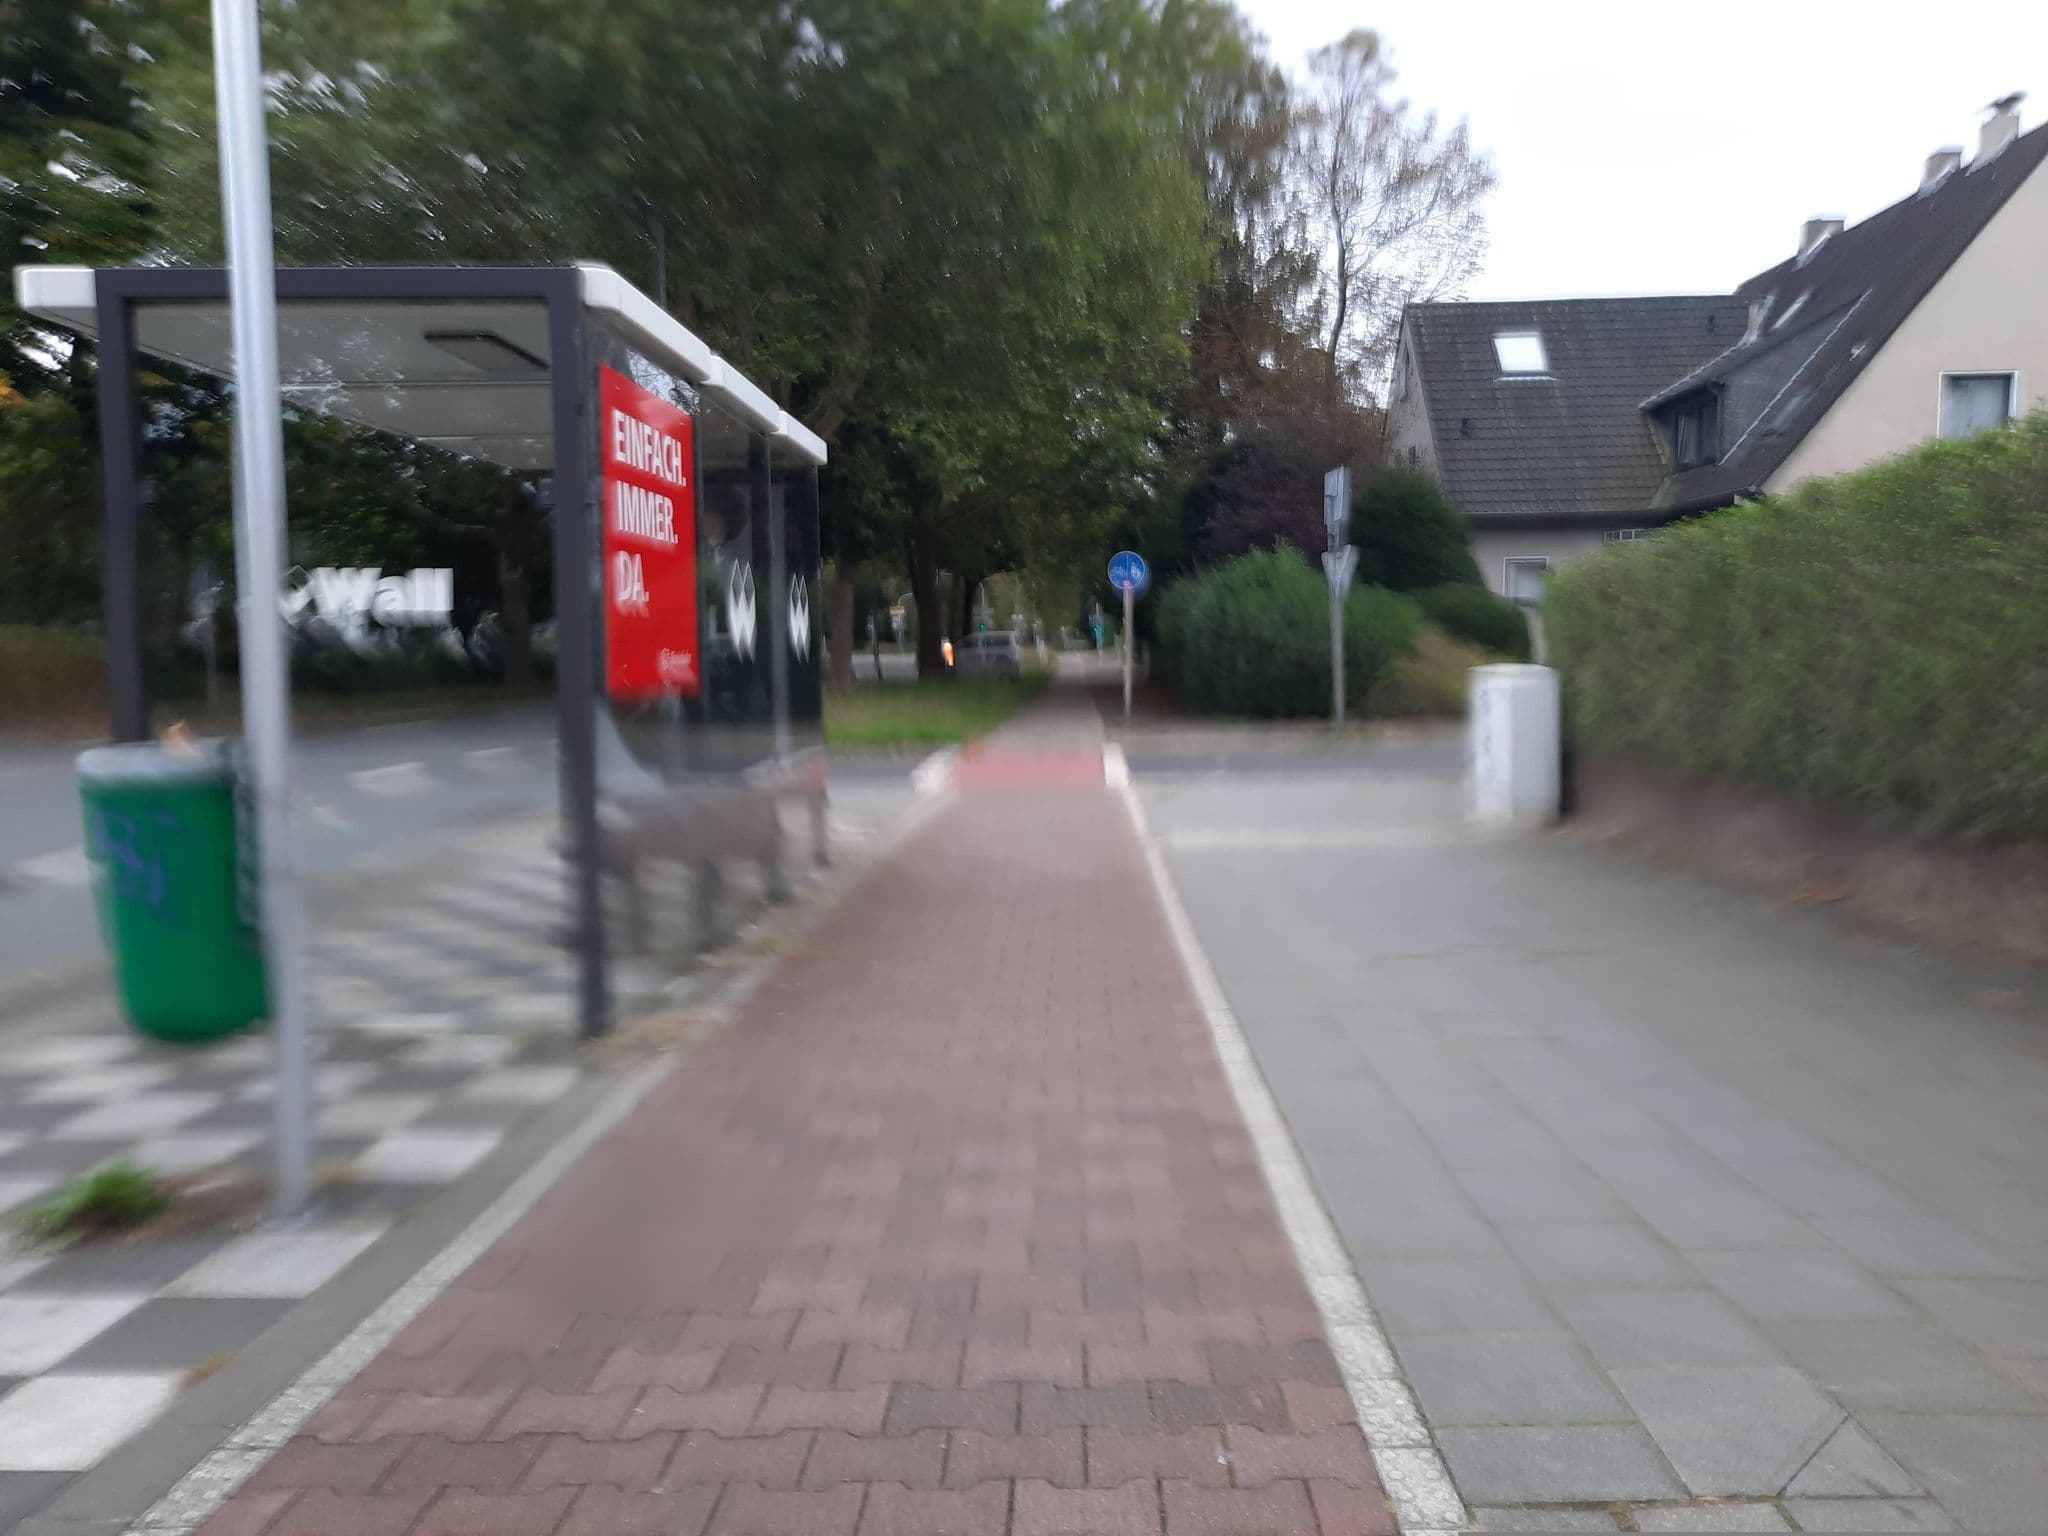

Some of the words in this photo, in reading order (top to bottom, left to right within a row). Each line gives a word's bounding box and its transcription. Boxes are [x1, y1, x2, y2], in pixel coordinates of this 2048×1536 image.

[613, 409, 687, 487] EINFACH.
[616, 480, 679, 544] IMMER.
[313, 566, 455, 624] Wall
[615, 551, 650, 606] DA.
